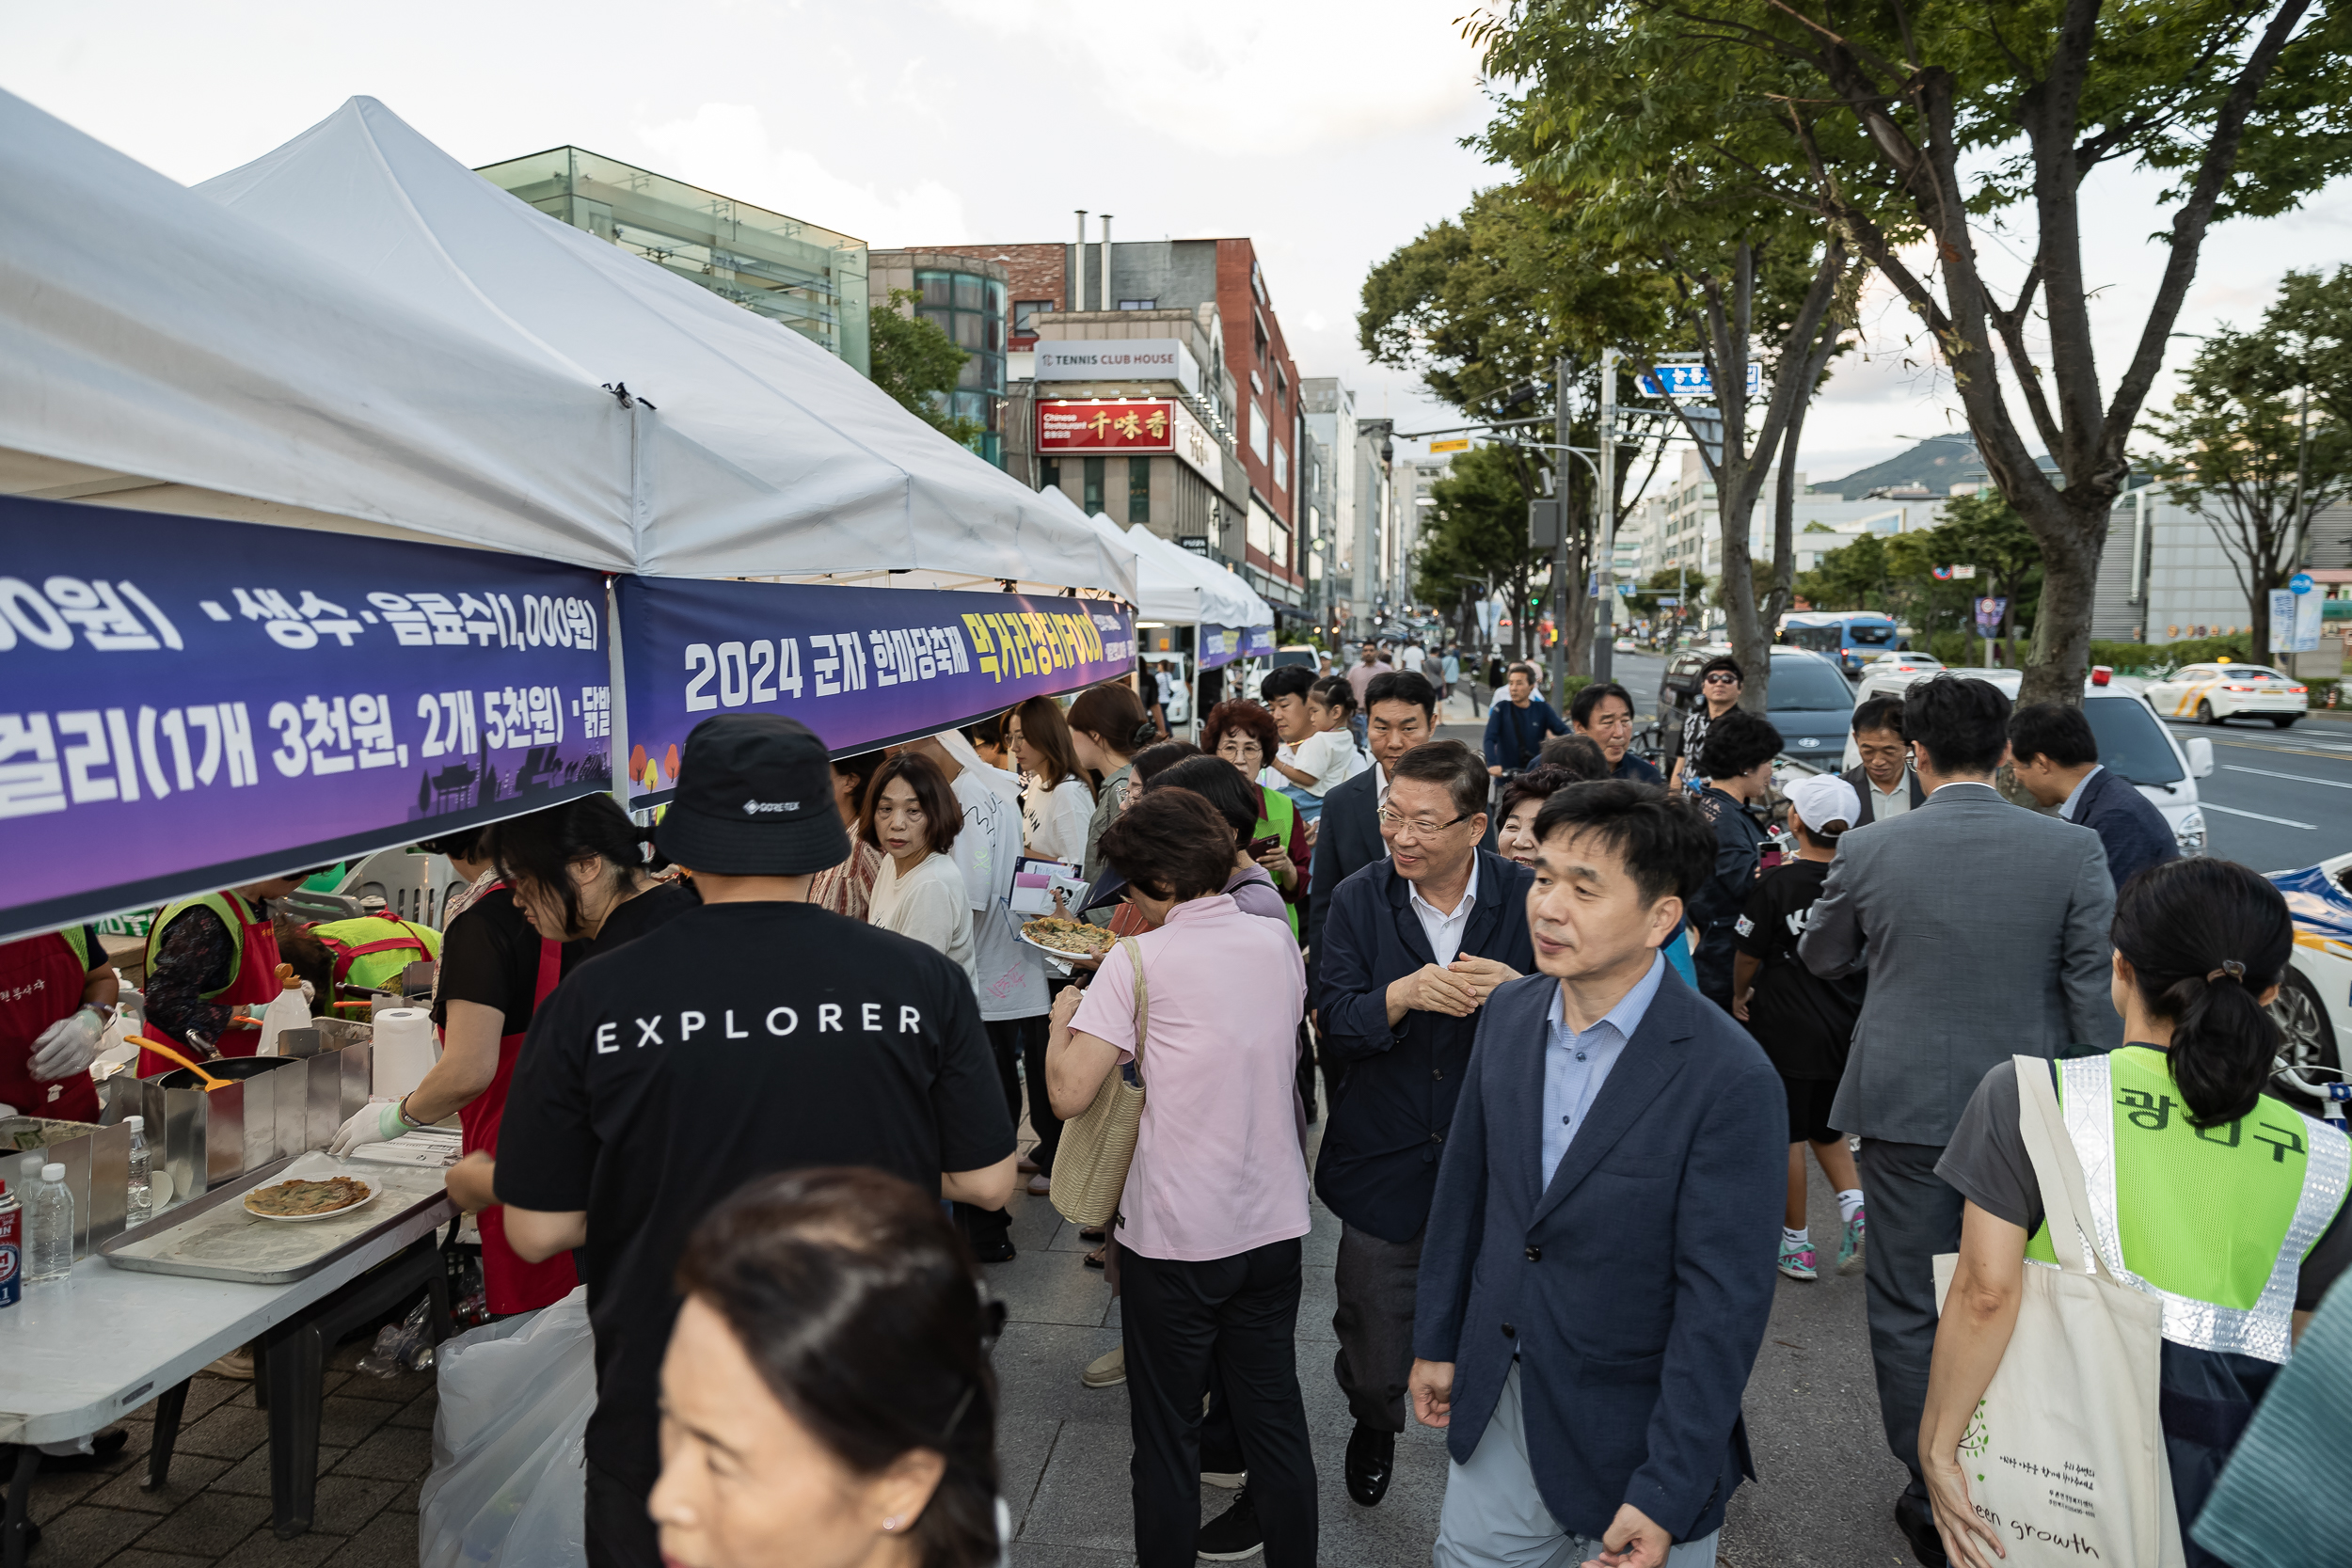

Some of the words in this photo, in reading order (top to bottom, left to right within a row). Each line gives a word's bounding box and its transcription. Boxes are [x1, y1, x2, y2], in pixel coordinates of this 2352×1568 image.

[1056, 355, 1098, 365] TENNIS
[1101, 355, 1131, 365] CLUB
[1134, 354, 1174, 365] HOUSE
[1043, 413, 1077, 422] Chinese
[1043, 421, 1088, 430] Restaurant
[1088, 409, 1168, 440] 千味香
[0, 576, 184, 652] 0원)
[685, 637, 803, 712] 2024
[809, 631, 867, 697] 군자
[868, 626, 970, 688] 한마당축제
[268, 693, 408, 779] 3천원,
[418, 690, 478, 758] 2개
[484, 686, 564, 750] 5천원)
[596, 1003, 921, 1054] EXPLORER
[1973, 1504, 2001, 1527] een
[2010, 1520, 2100, 1560] growth
